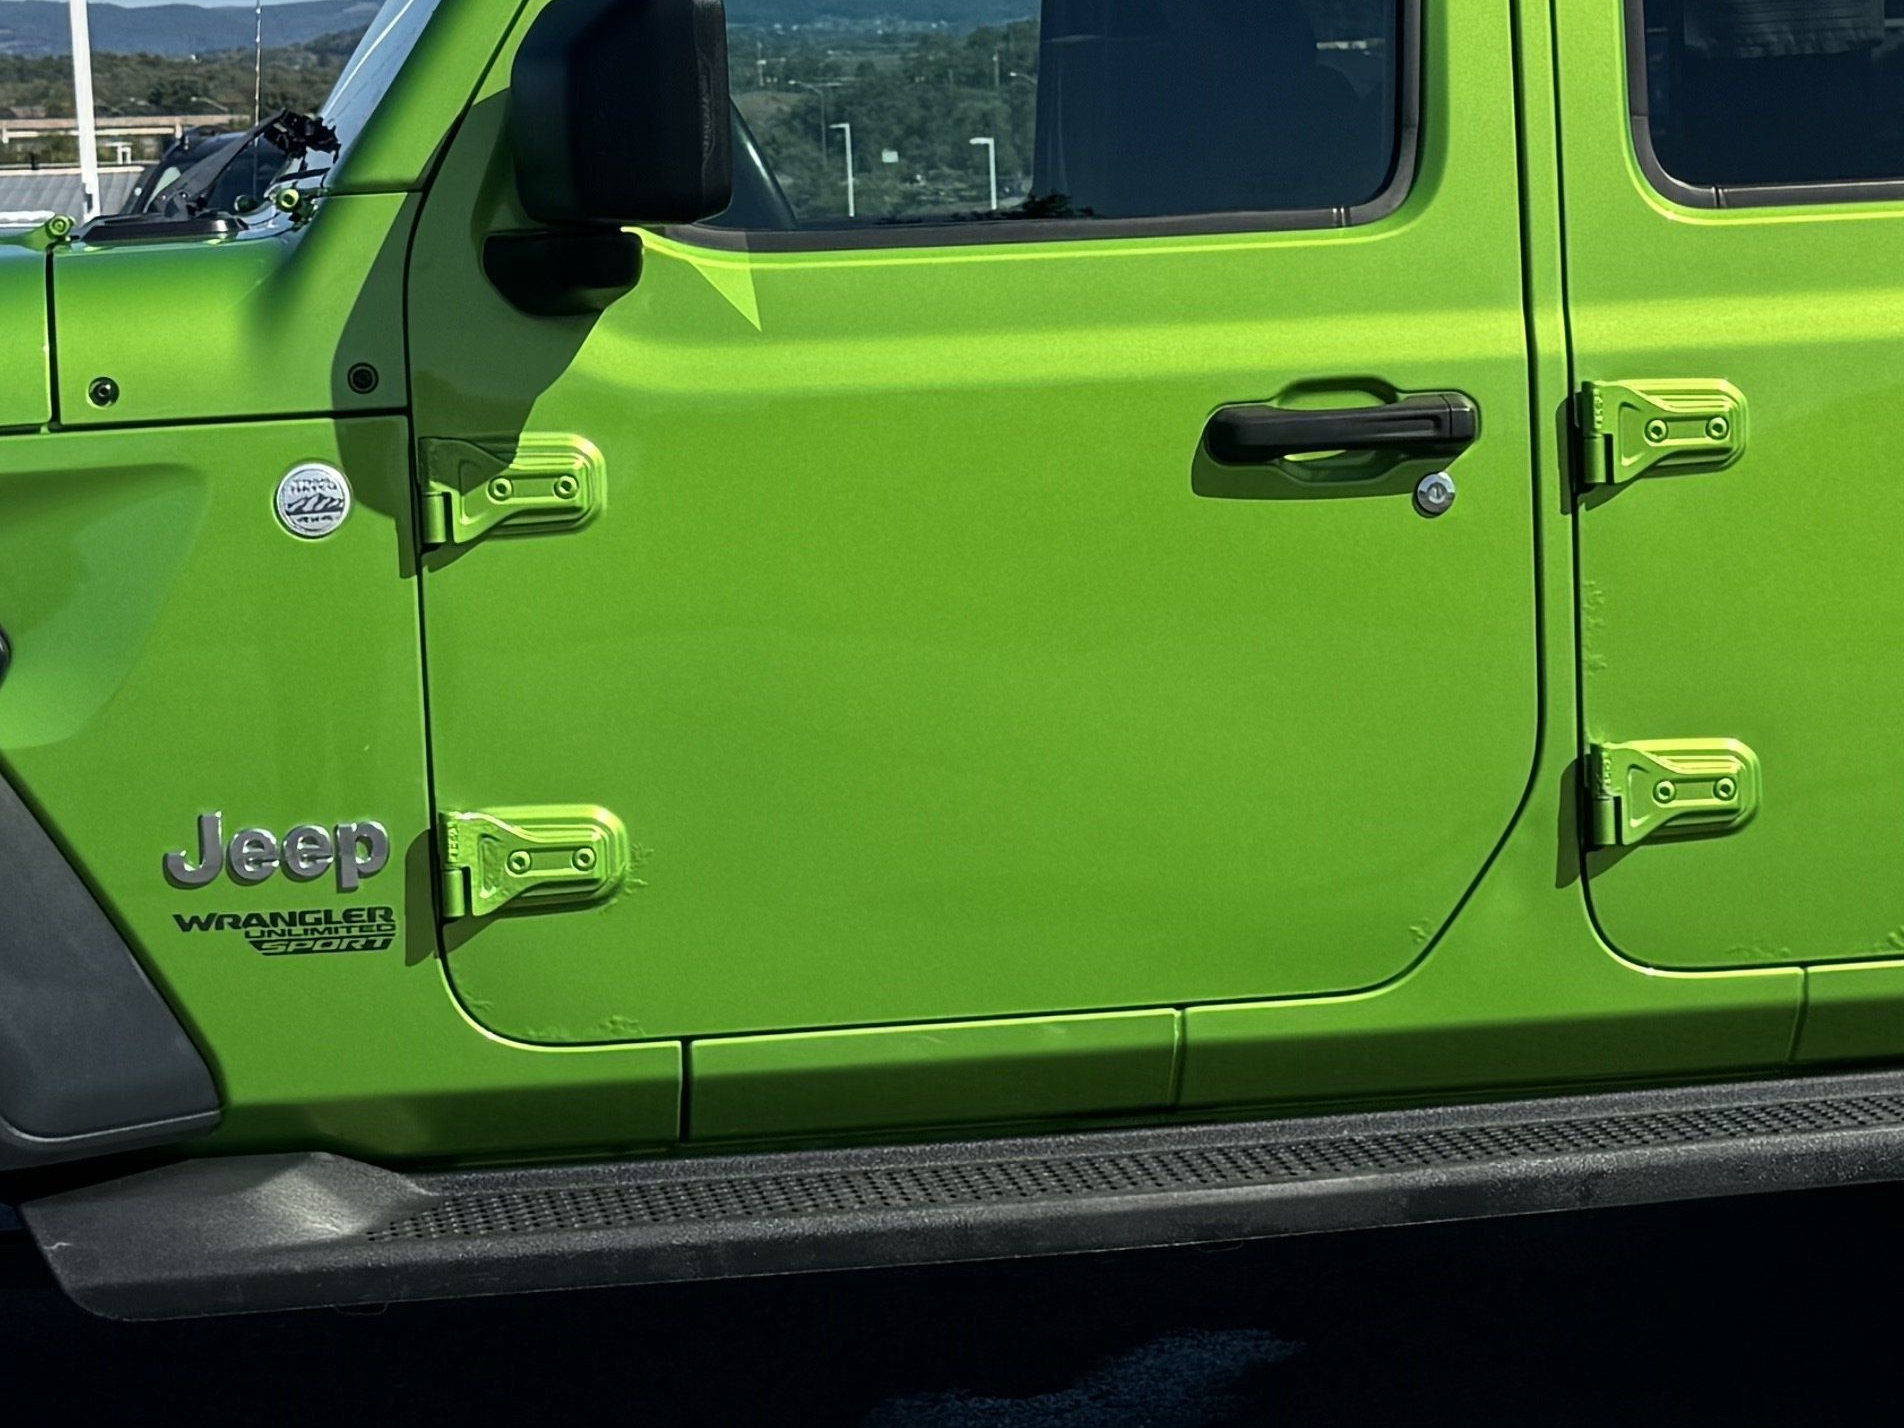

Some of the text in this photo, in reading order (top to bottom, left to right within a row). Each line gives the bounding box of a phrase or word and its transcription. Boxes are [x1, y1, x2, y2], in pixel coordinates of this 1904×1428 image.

[162, 810, 390, 894] Jeep
[172, 906, 396, 933] WRANGLER
[244, 923, 396, 940] UNLIMITED
[260, 937, 388, 953] SPORT
